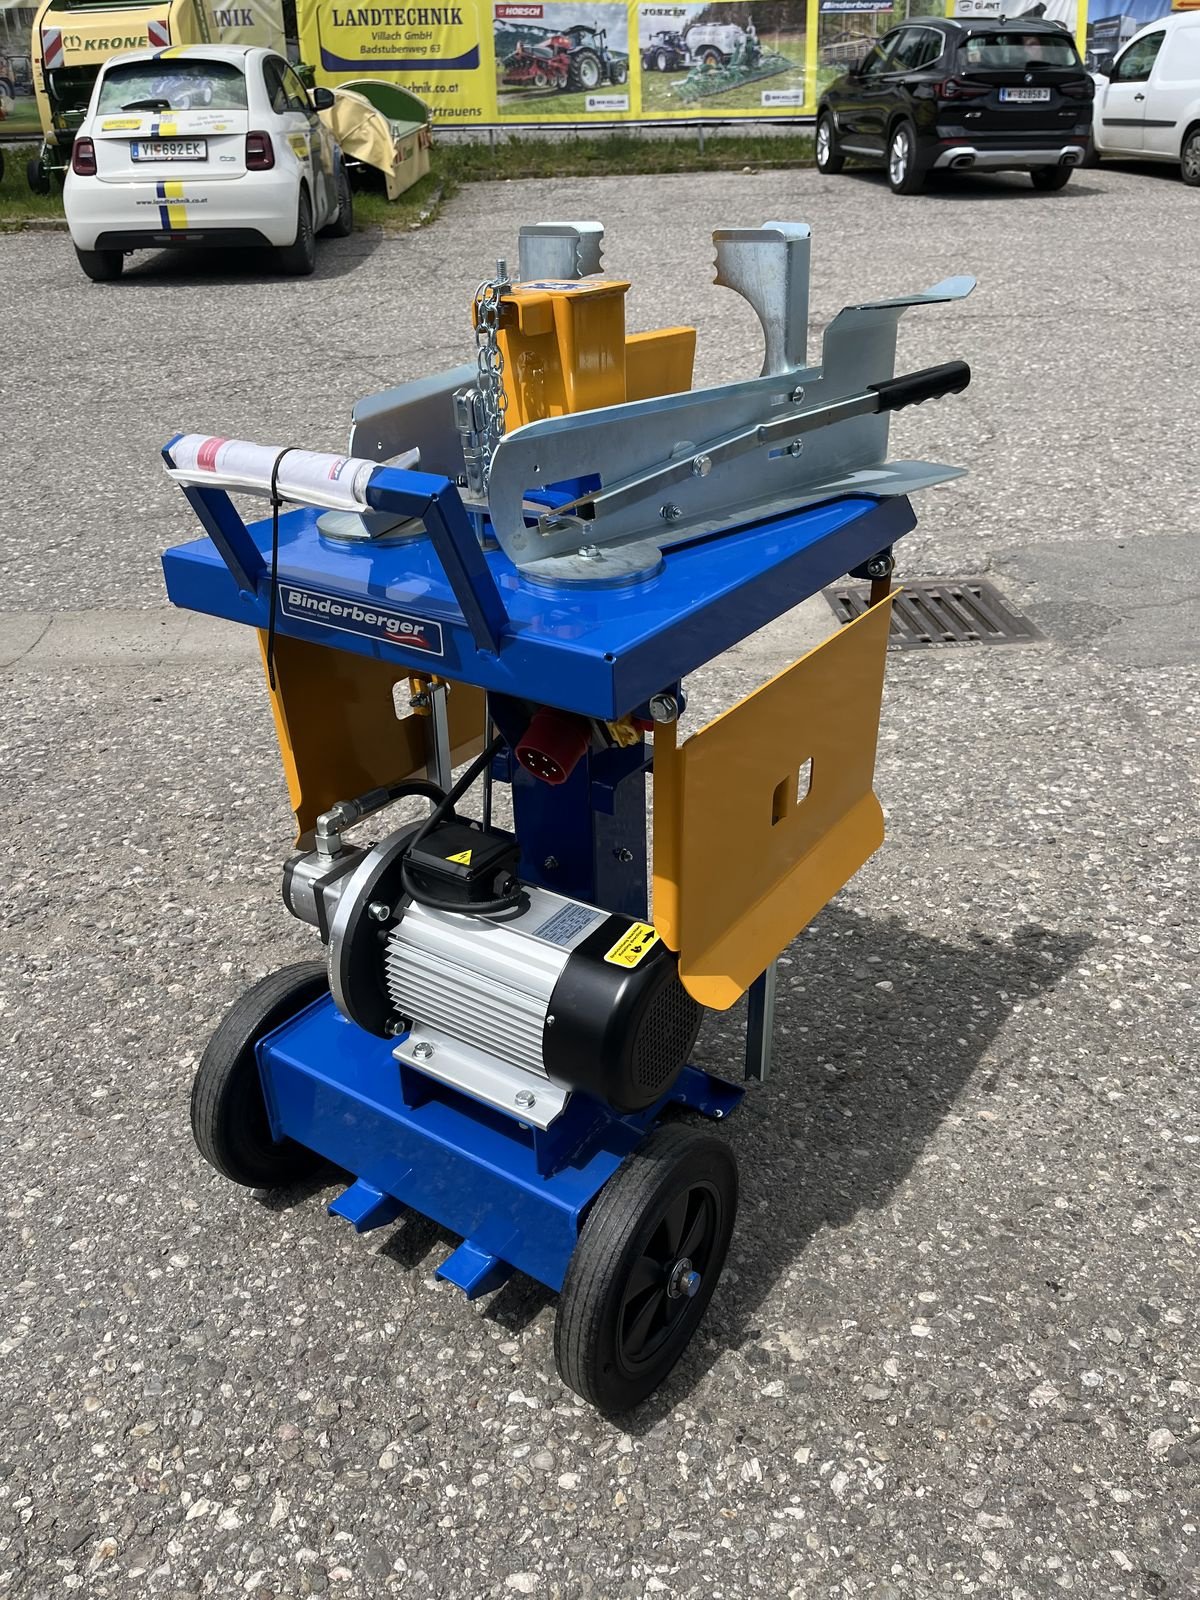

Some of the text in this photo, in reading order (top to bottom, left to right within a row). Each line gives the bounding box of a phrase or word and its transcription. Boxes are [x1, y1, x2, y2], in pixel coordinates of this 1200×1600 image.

[822, 1, 892, 10] Binderberger
[332, 7, 464, 27] LANDTECHNIK
[505, 7, 541, 16] HORSCH
[641, 6, 687, 17] JOSKIN
[371, 31, 433, 41] Villach GmbH
[84, 35, 148, 51] KRONE
[360, 44, 441, 55] Badstubenweg 63
[427, 107, 482, 118] ertrauens
[135, 197, 208, 205] www.landtechnik.co.at
[287, 591, 425, 636] Binderberger
